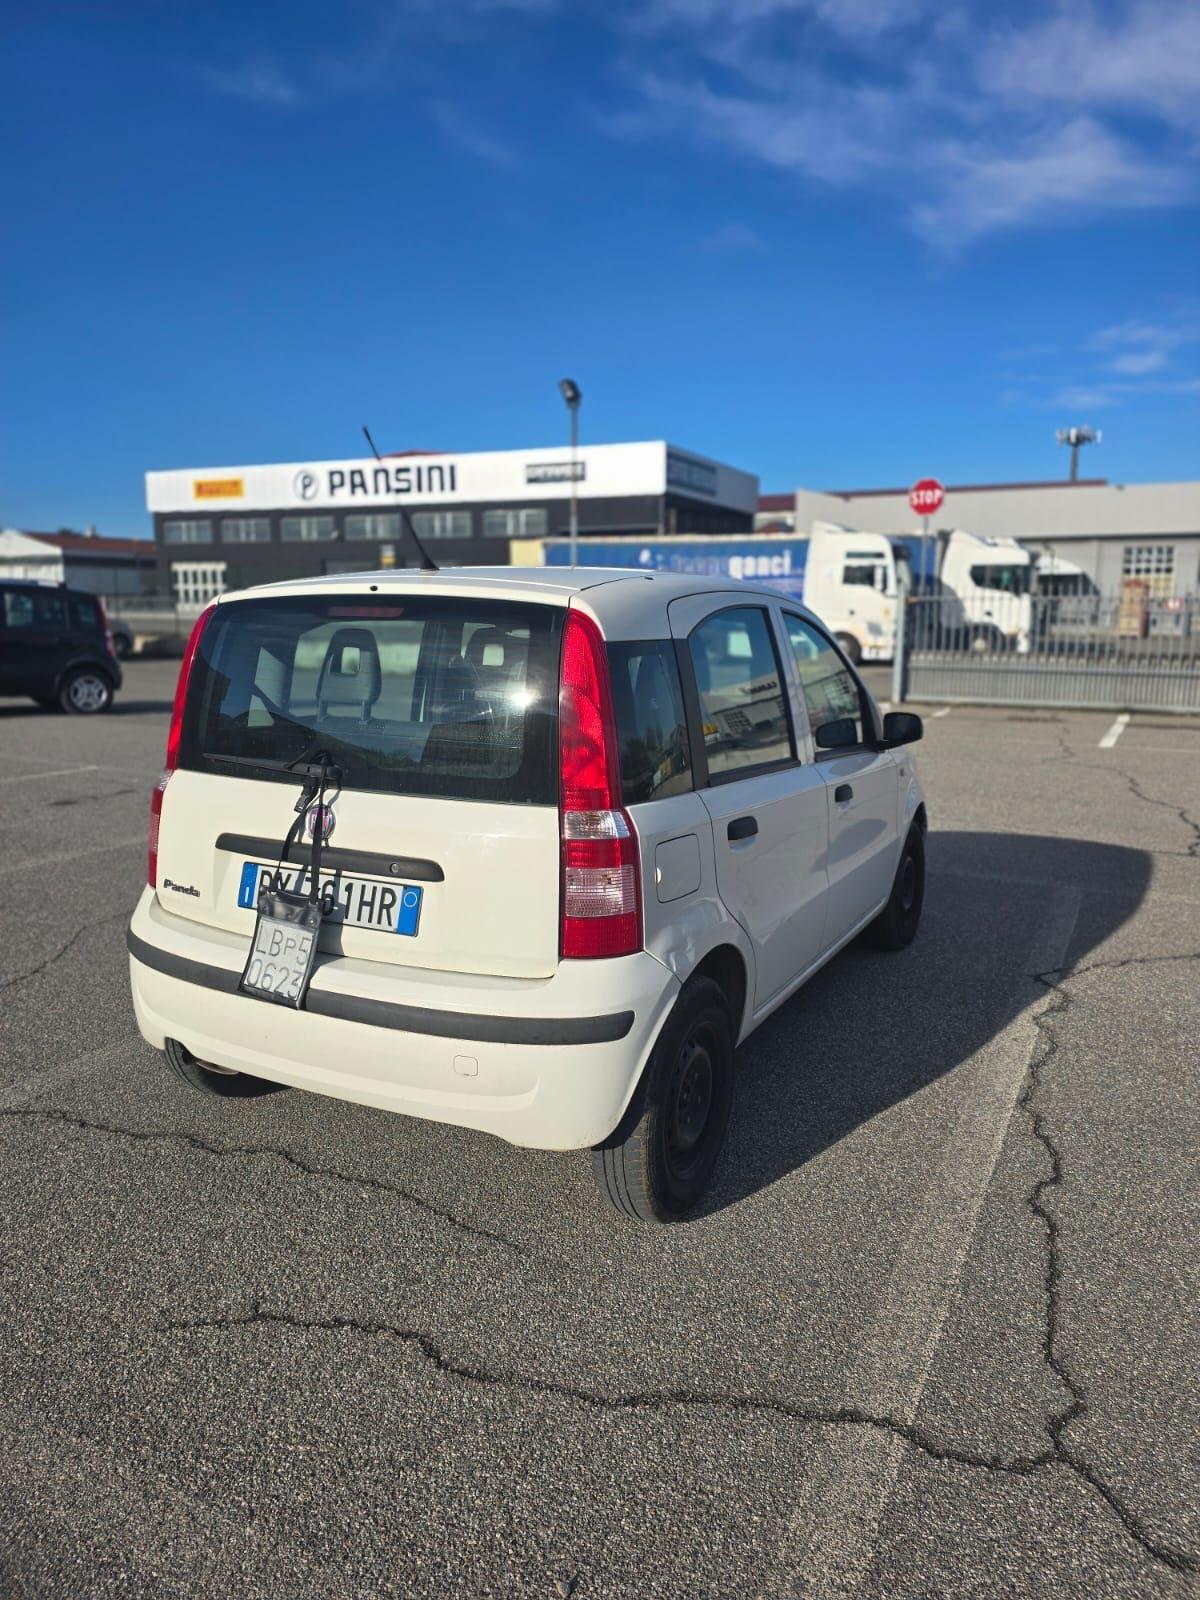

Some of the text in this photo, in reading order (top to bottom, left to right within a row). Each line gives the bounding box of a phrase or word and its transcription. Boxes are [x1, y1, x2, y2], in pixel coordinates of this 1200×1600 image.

[329, 465, 456, 496] PANSINI
[911, 489, 942, 505] STOP
[163, 878, 201, 897] Panda
